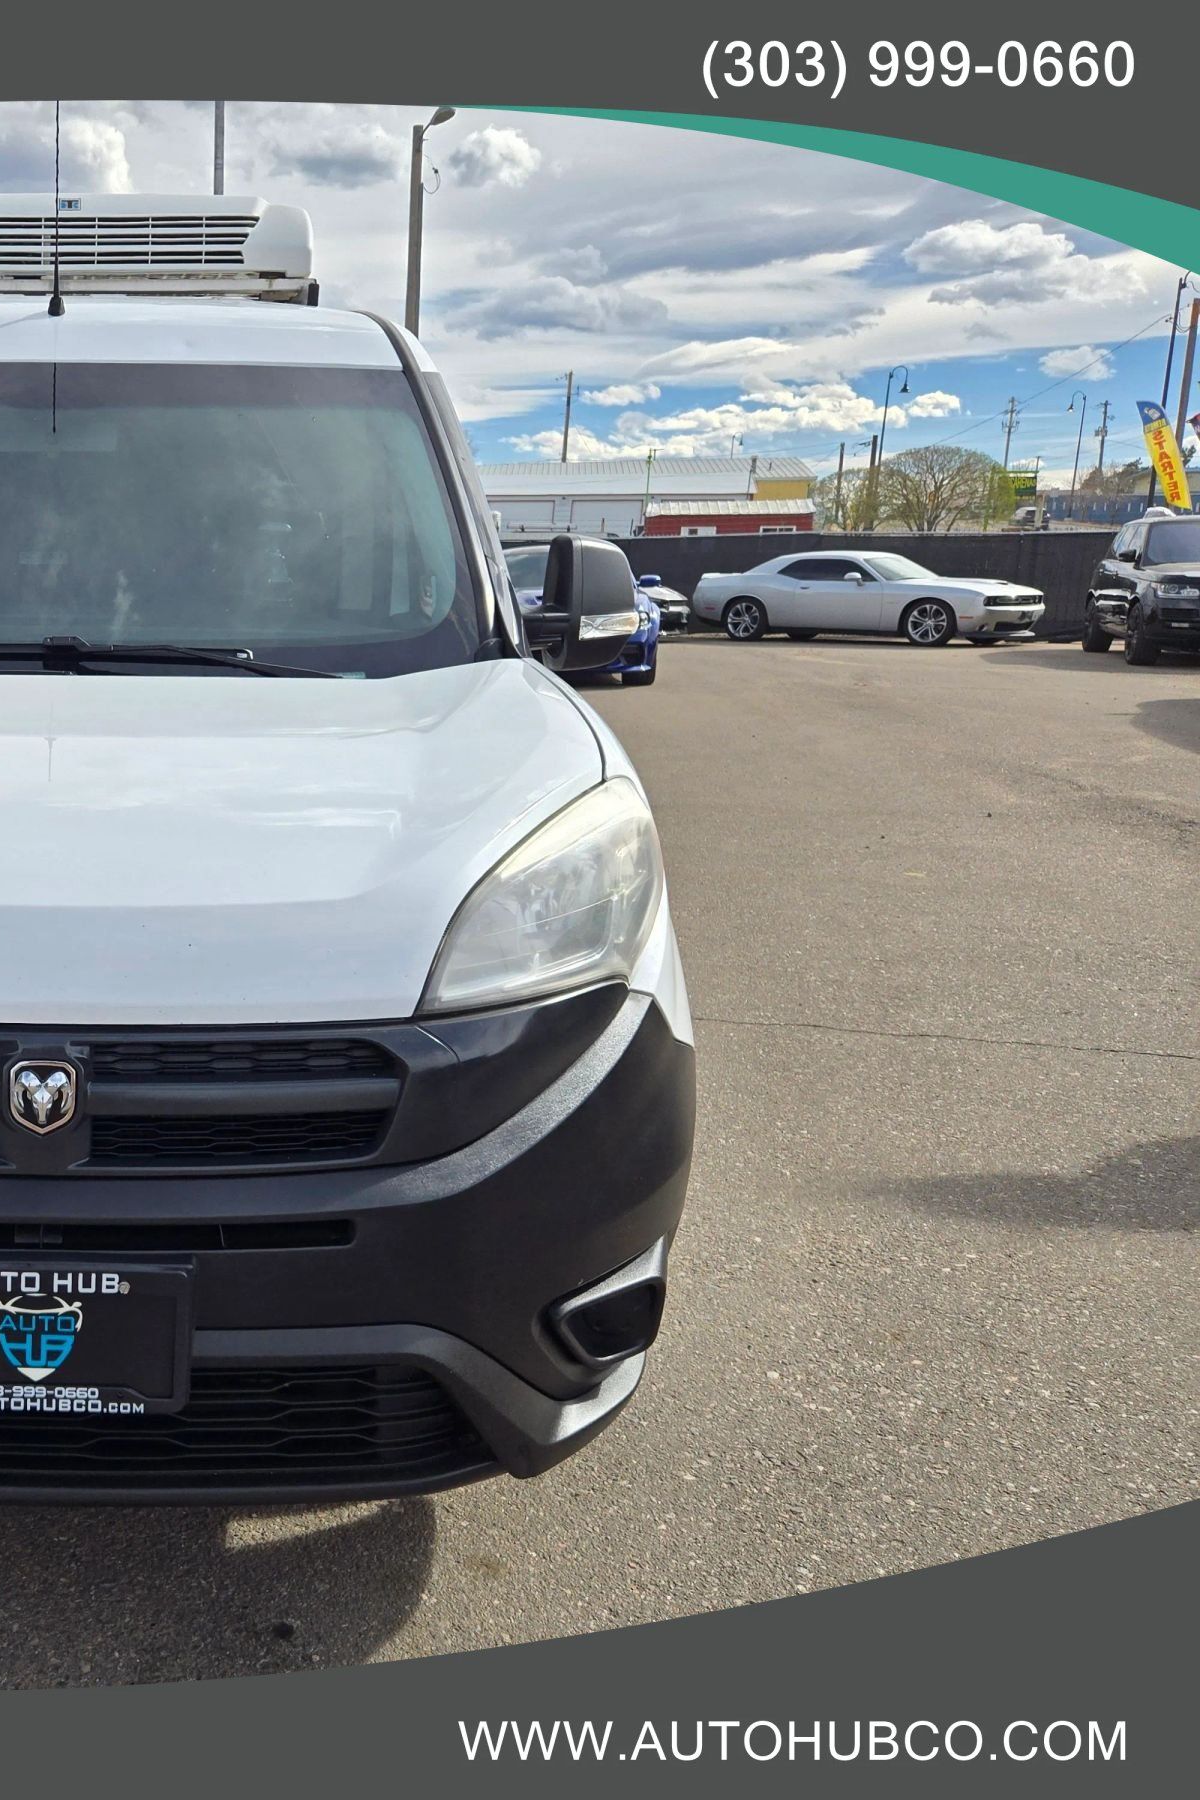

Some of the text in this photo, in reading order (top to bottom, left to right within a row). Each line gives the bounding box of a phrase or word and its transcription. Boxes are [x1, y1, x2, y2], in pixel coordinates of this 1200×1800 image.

[53, 1272, 121, 1294] HUB
[0, 1314, 75, 1332] AUTO
[0, 1333, 75, 1367] HUB
